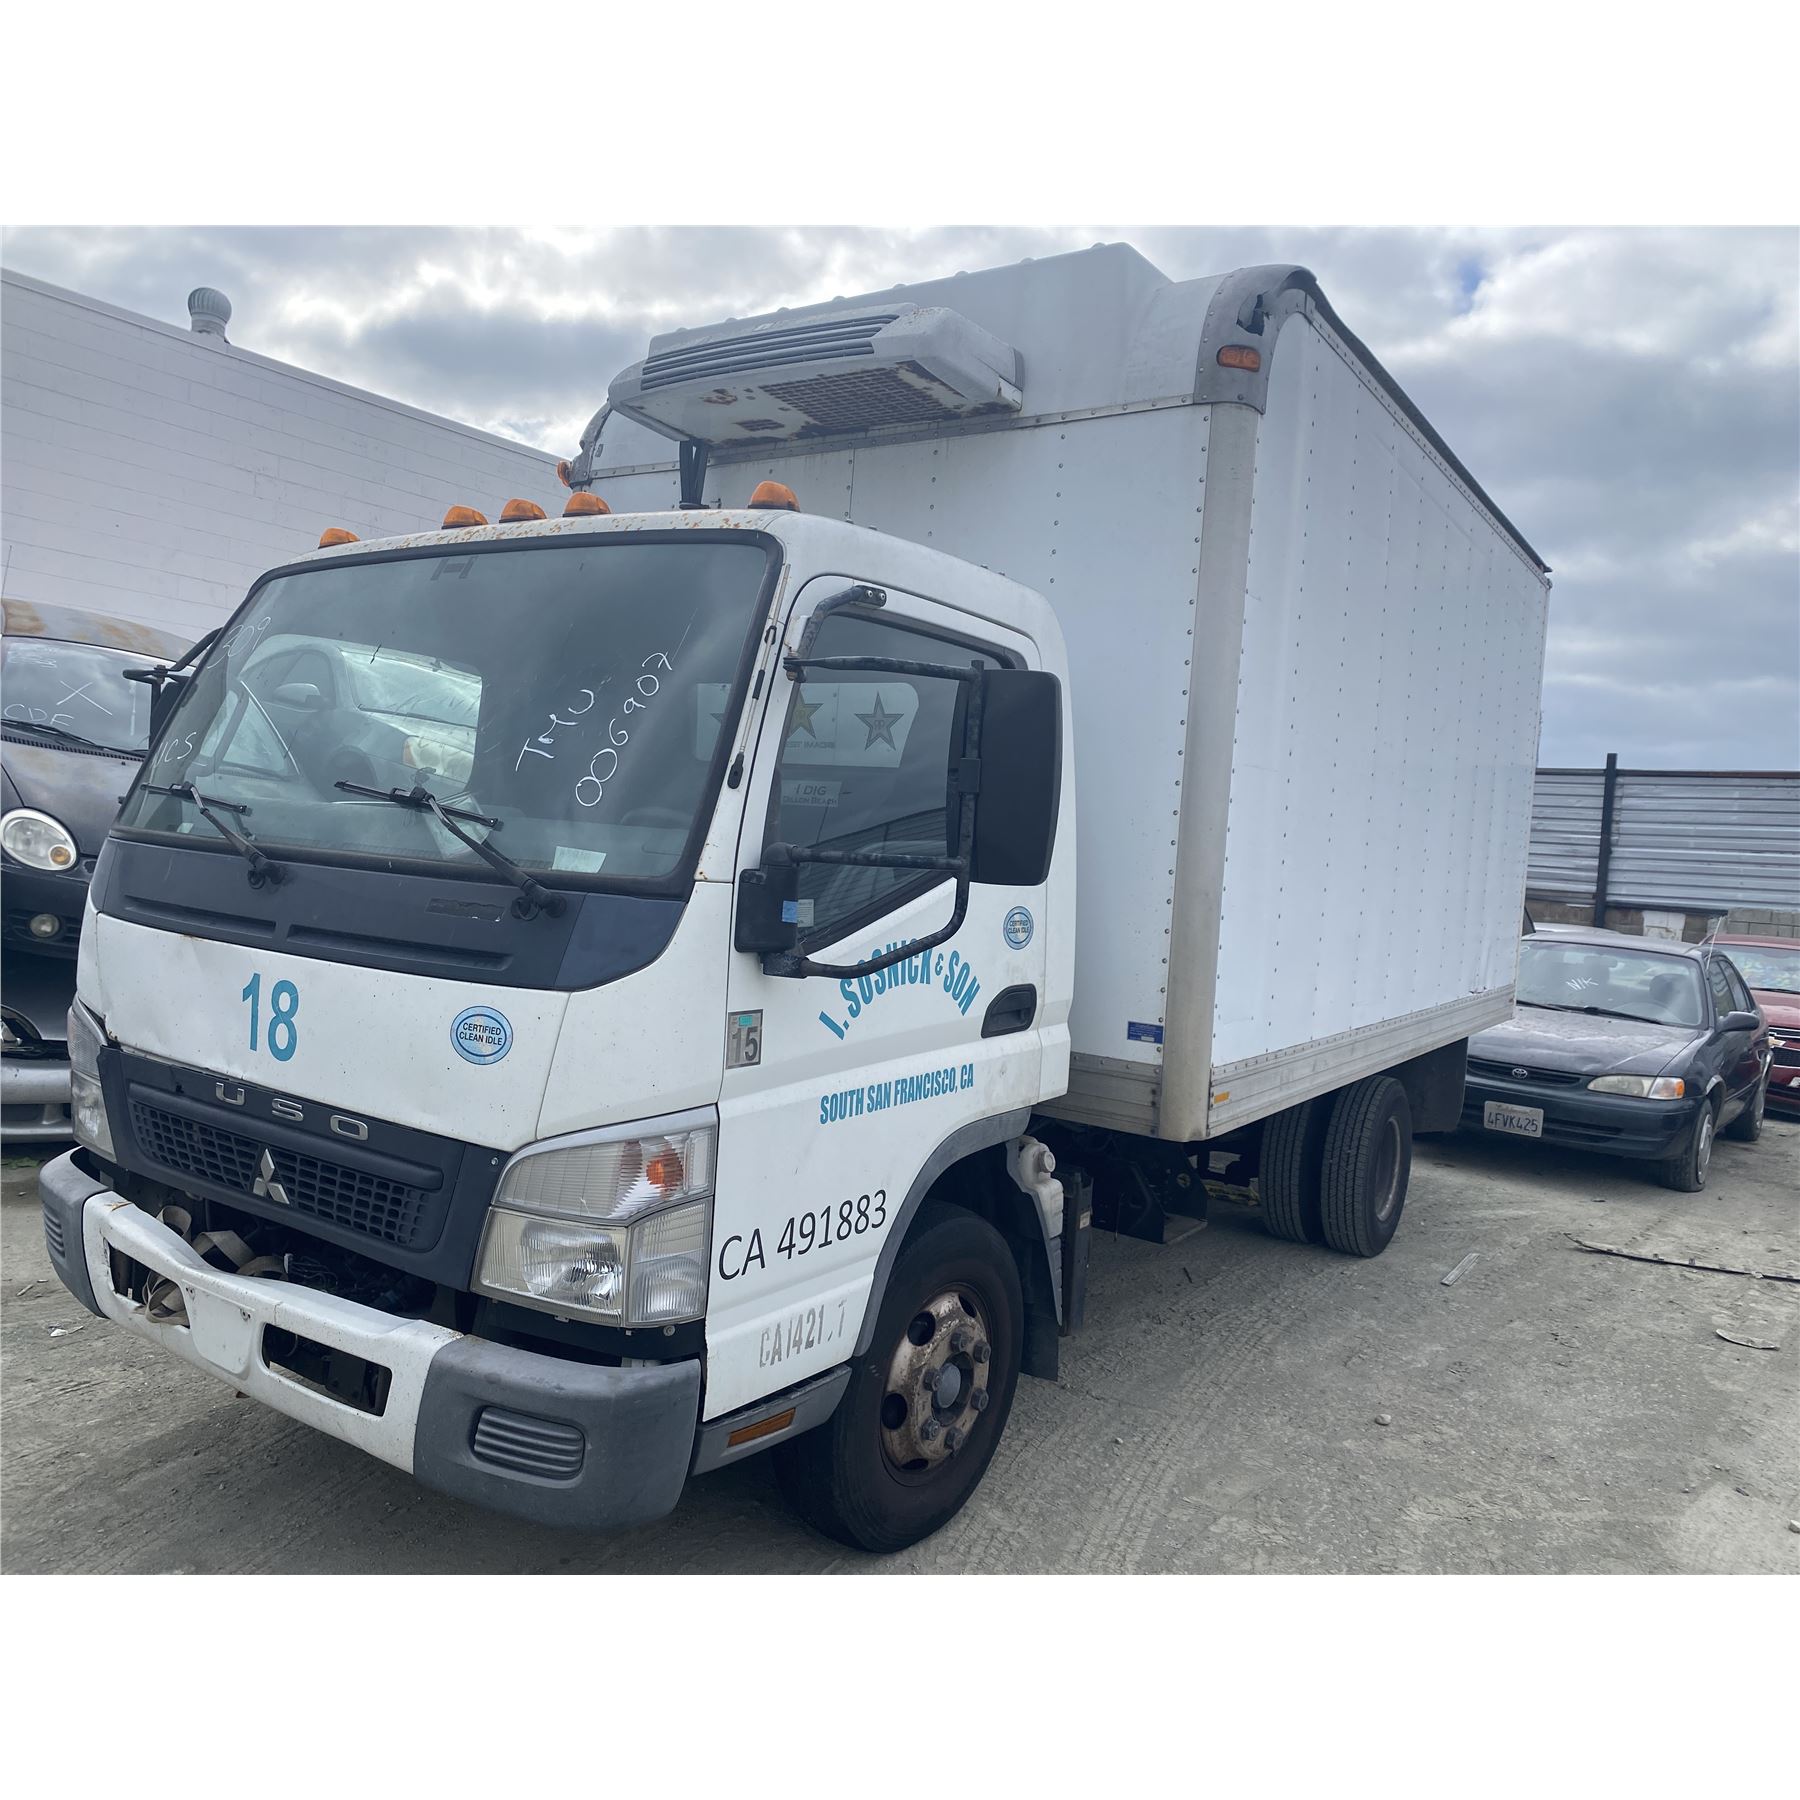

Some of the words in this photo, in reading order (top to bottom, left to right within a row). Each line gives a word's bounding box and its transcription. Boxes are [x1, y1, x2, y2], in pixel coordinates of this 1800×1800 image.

[803, 785, 827, 797] DIG
[934, 952, 944, 977] &
[943, 950, 981, 1017] SON
[242, 972, 300, 1063] 18
[462, 1022, 502, 1036] CERTIFIED
[459, 1031, 484, 1043] CLEAN
[485, 1035, 503, 1046] IDLE
[731, 1026, 759, 1064] 15
[819, 1087, 865, 1125] SOUTH
[866, 1081, 893, 1114] SAN
[893, 1066, 959, 1106] FRANCISCO,
[959, 1063, 975, 1089] CA
[1487, 1111, 1539, 1133] 4FVK425
[718, 1227, 766, 1281] CA
[776, 1189, 888, 1261] 491883
